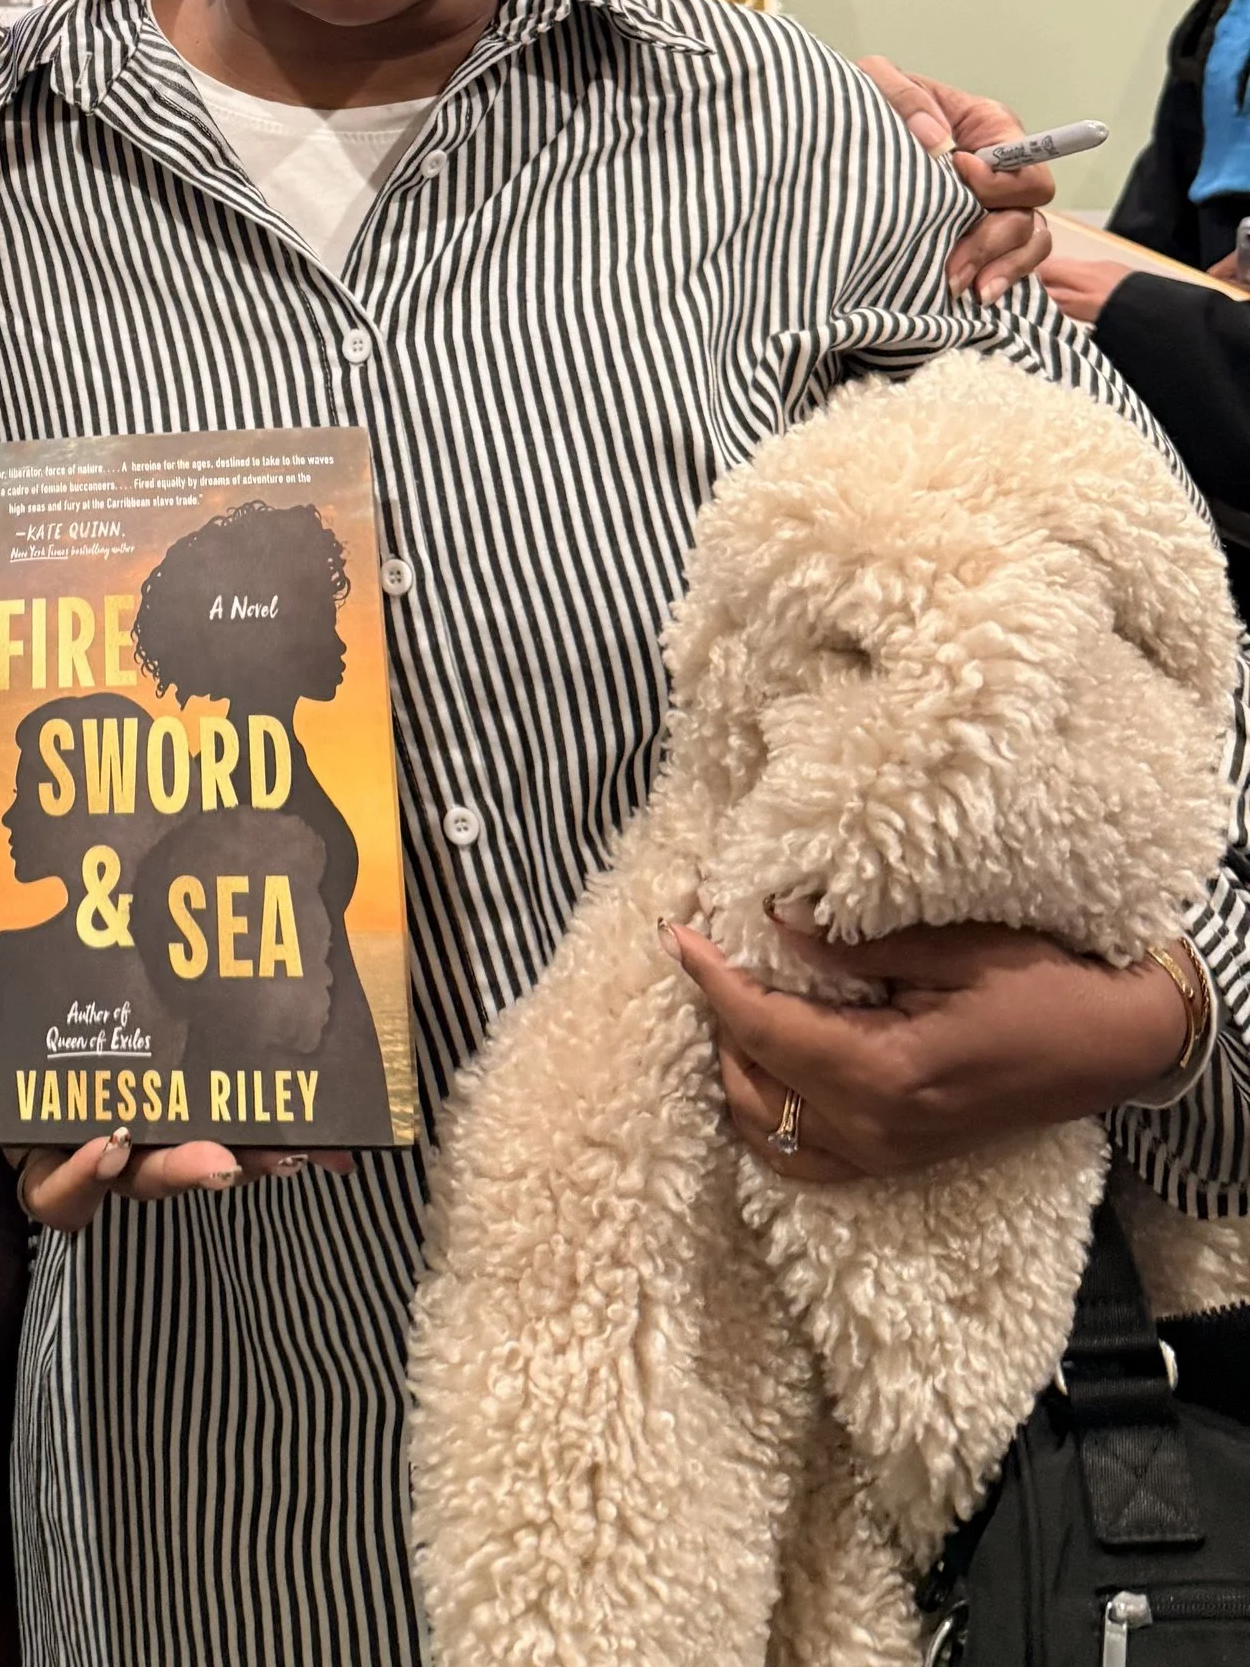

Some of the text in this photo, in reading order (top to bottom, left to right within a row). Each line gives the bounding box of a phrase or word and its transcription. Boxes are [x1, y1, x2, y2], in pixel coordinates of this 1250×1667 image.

[45, 465, 65, 476] force
[68, 464, 76, 474] of
[122, 462, 128, 472] A
[132, 460, 162, 472] heroine
[164, 460, 176, 470] for
[177, 458, 190, 469] the
[215, 456, 250, 468] destined
[252, 456, 260, 466] to
[262, 455, 280, 466] take
[282, 455, 290, 465] to
[292, 454, 305, 465] the
[308, 456, 334, 464] waves
[0, 488, 6, 496] a
[8, 484, 29, 496] cadre
[30, 484, 38, 494] of
[40, 482, 66, 494] female
[134, 478, 154, 488] Fired
[156, 476, 186, 490] equally
[188, 476, 198, 489] by
[200, 476, 230, 486] dreams
[232, 474, 240, 485] of
[242, 473, 283, 484] adventure
[286, 474, 296, 483] on
[298, 472, 311, 482] the
[8, 502, 25, 516] high
[27, 503, 45, 513] seas
[48, 500, 61, 512] and
[63, 499, 80, 512] fury
[82, 500, 90, 510] at
[92, 498, 104, 509] the
[152, 495, 174, 506] slave
[209, 594, 278, 621] A Novel
[38, 714, 293, 817] SWORD
[75, 844, 135, 949] &
[167, 874, 304, 979] SEA
[66, 1000, 131, 1025] Author of
[46, 1026, 151, 1054] Queen of Exiles
[15, 1070, 319, 1122] VANESSA RILEY
